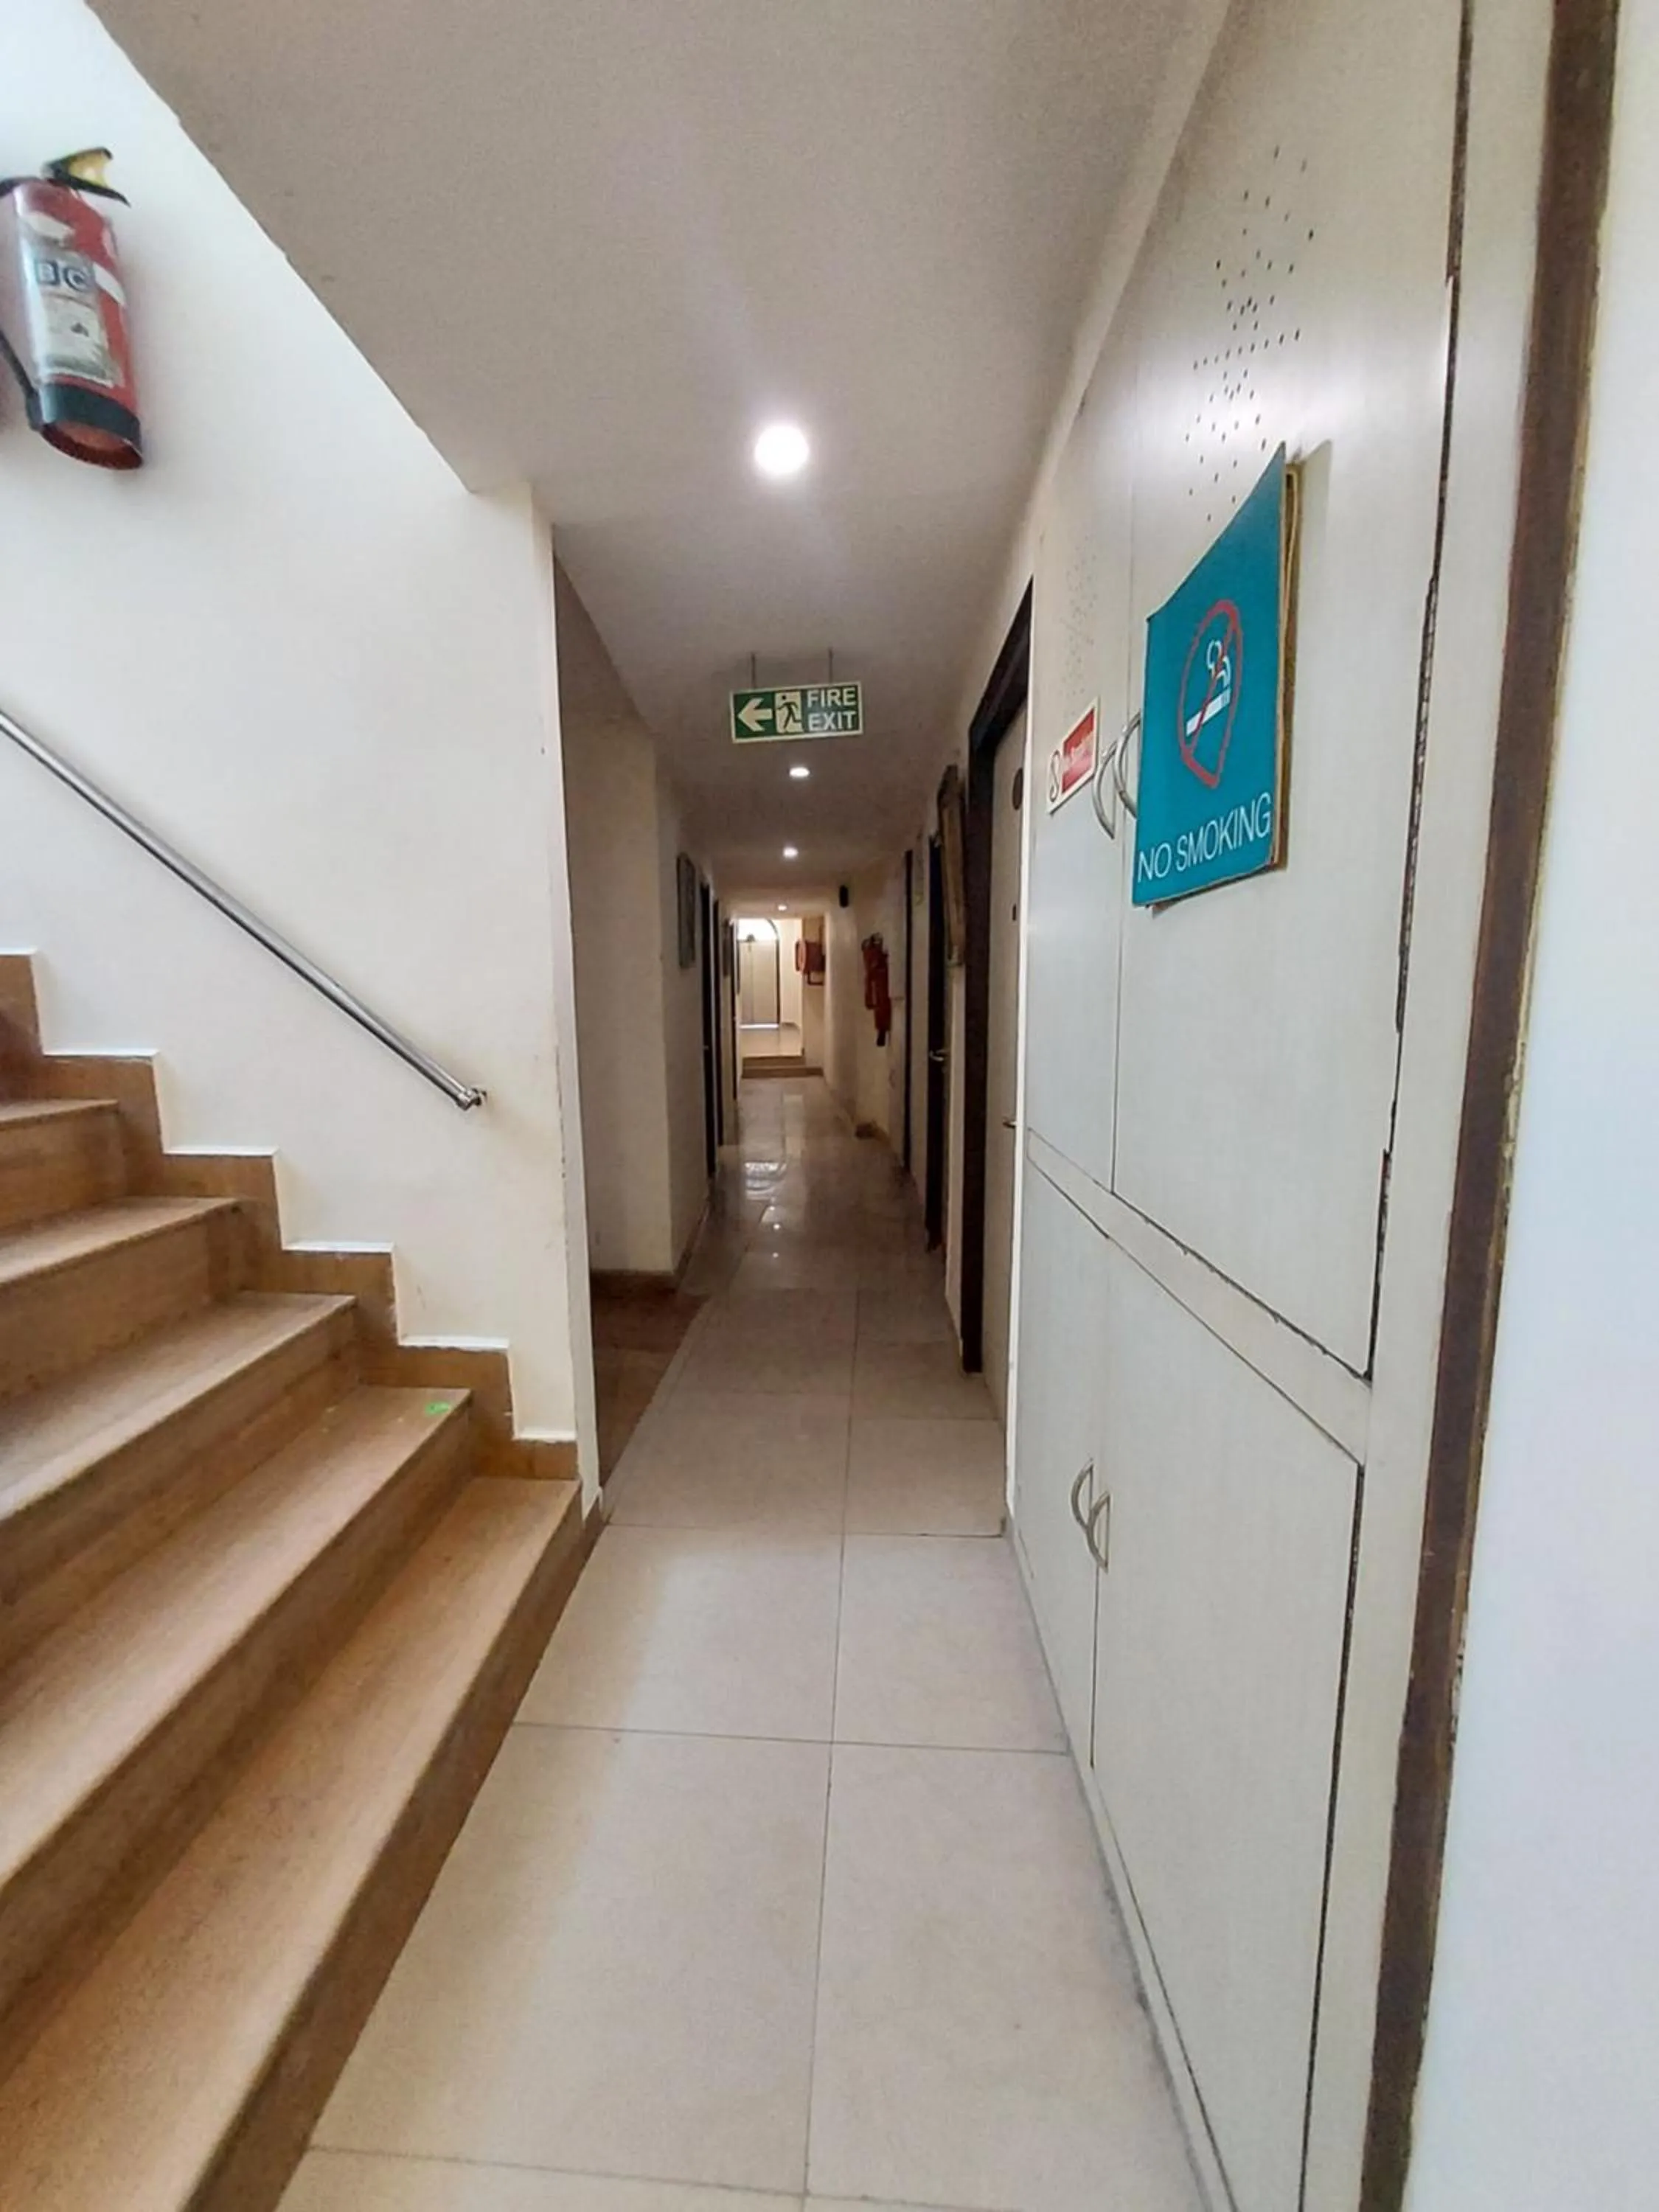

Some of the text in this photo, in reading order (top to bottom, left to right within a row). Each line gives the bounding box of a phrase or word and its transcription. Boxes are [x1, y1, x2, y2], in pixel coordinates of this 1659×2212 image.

[806, 687, 857, 709] FIRE
[807, 710, 857, 732] EXIT
[1138, 791, 1272, 883] NO SMOKING
